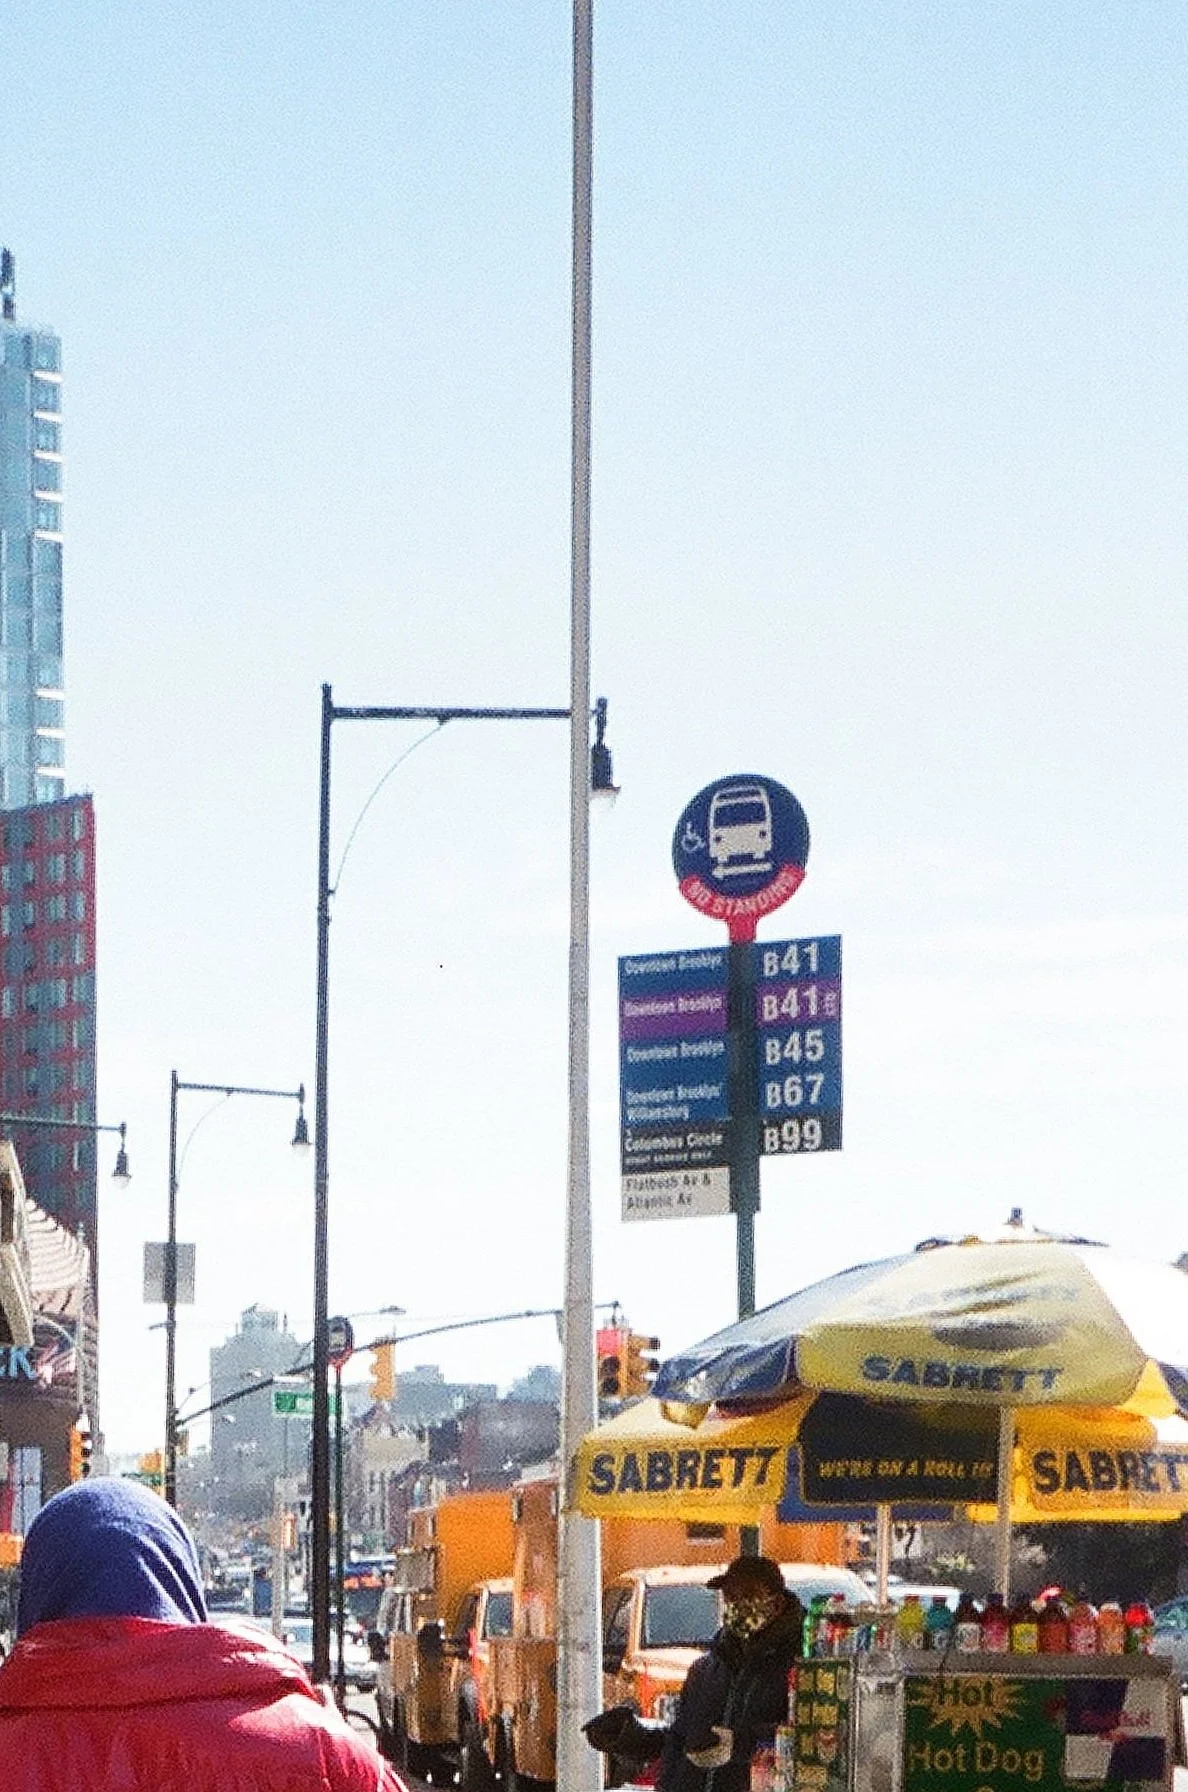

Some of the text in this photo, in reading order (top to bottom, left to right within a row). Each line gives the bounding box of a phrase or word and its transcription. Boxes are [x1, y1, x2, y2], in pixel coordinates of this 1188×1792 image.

[763, 942, 820, 976] B41
[763, 985, 818, 1021] B41
[765, 1029, 824, 1066] B45
[765, 1072, 825, 1109] B67
[763, 1118, 822, 1153] B99
[862, 1355, 1064, 1392] SABRETT
[590, 1447, 780, 1495] SABRETT
[936, 1680, 994, 1705] Hot
[911, 1741, 1044, 1782] Hot Dog
